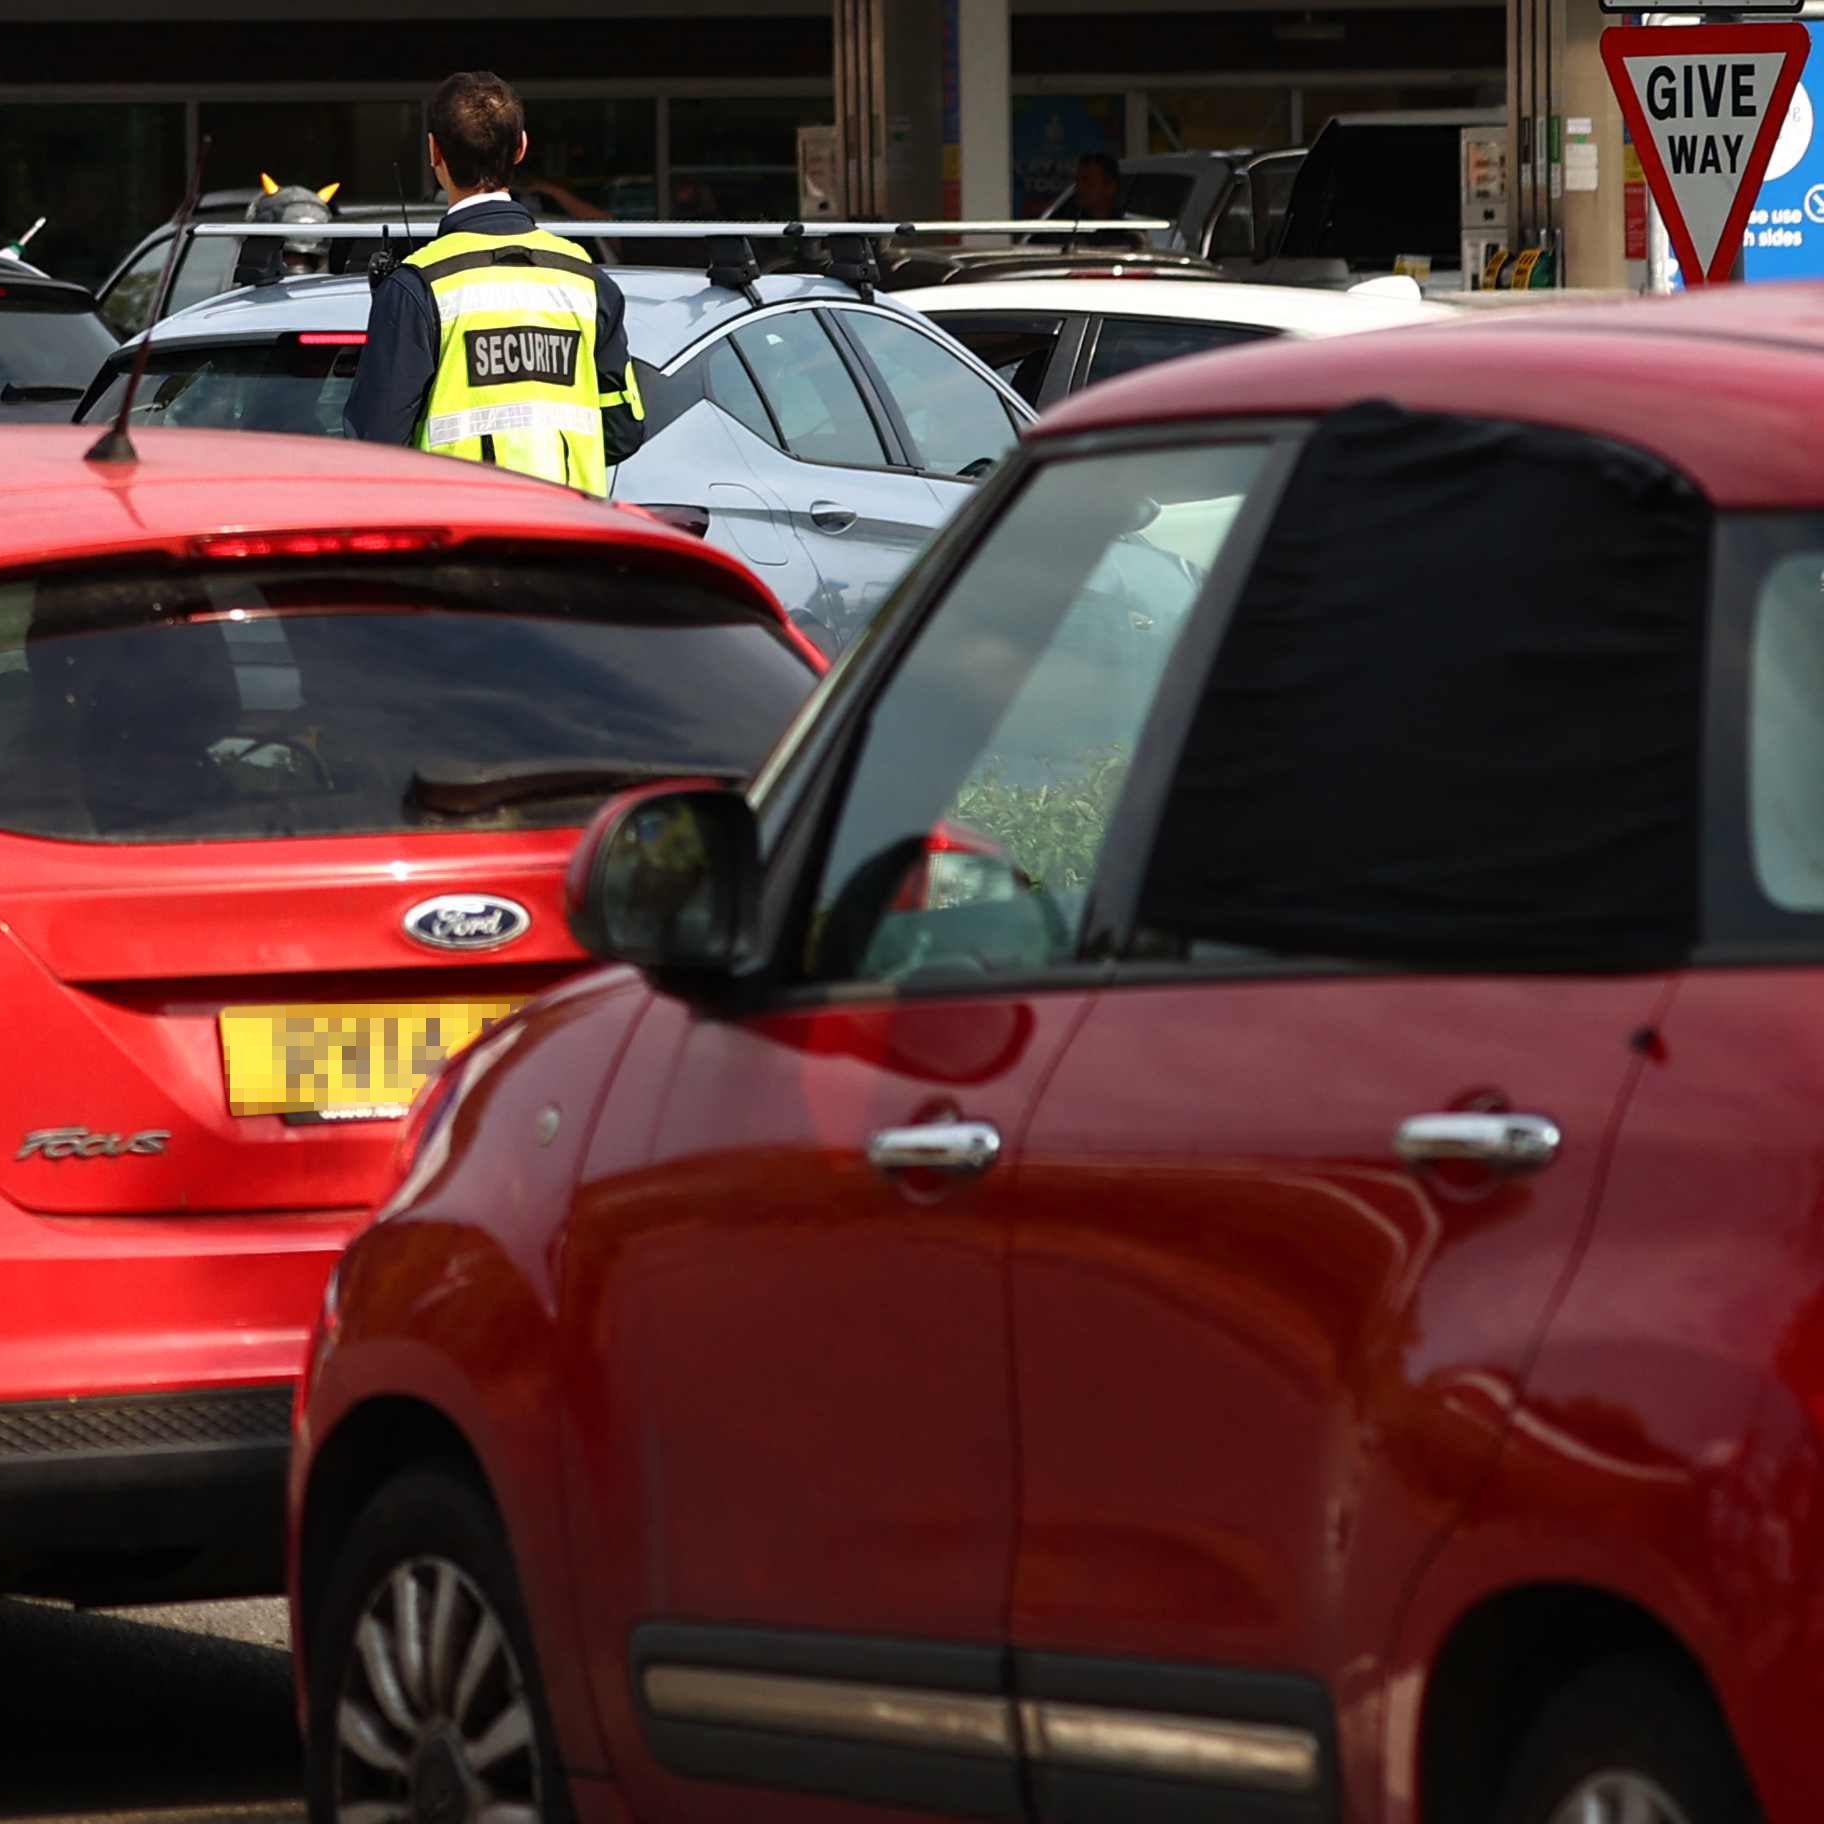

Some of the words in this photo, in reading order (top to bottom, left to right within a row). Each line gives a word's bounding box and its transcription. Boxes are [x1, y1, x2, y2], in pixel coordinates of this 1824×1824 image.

[1646, 63, 1757, 121] GIVE
[1667, 134, 1745, 175] WAY
[475, 332, 573, 377] SECURITY
[433, 907, 503, 936] Ford
